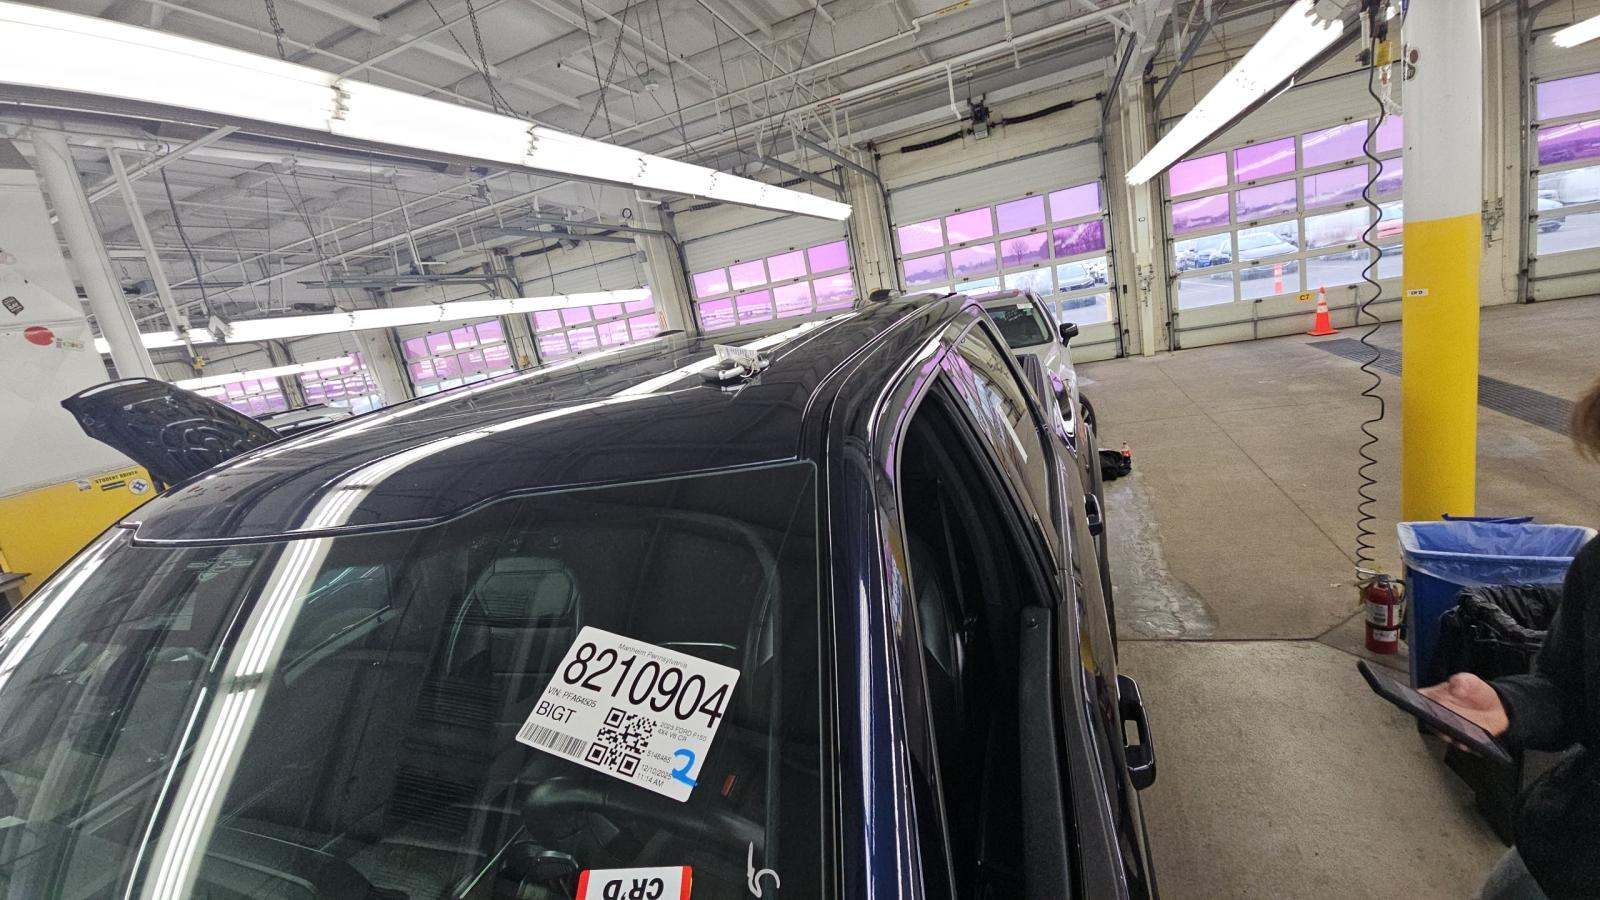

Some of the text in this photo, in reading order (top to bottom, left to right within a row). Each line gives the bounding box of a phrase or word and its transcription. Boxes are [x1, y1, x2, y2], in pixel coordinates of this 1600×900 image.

[563, 641, 731, 729] 8210904
[536, 701, 576, 724] BIGT
[672, 748, 698, 788] 2
